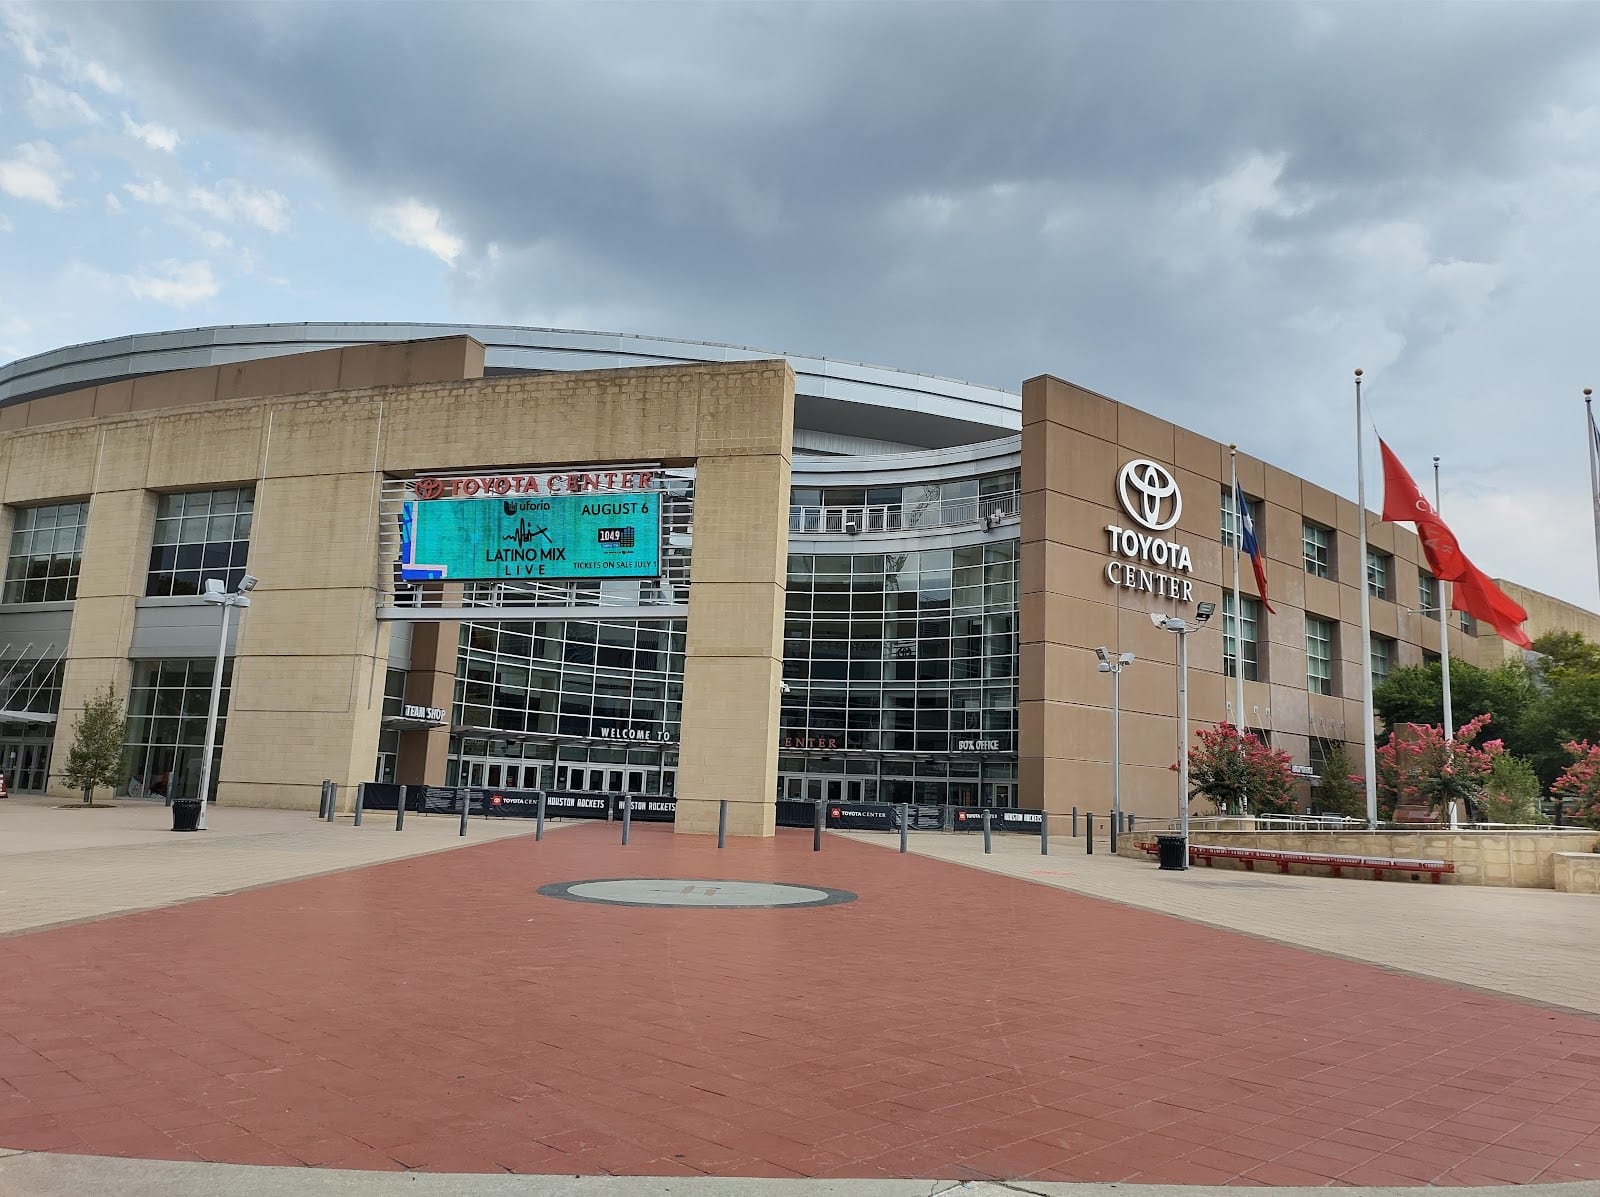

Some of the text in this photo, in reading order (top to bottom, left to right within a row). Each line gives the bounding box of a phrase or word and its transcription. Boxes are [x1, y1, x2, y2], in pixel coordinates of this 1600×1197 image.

[451, 472, 653, 496] TOYOTA CENTER
[520, 500, 550, 511] uforia
[582, 502, 649, 515] AUGUST 6
[486, 547, 566, 562] LATINO MIX
[1106, 525, 1193, 572] TOYOTA
[505, 564, 545, 576] LIVE
[602, 561, 615, 569] ON
[616, 561, 633, 569] SALE
[1105, 561, 1193, 602] CENTER
[404, 704, 446, 721] TEAM SHOP
[601, 727, 670, 741] WELCOME TO
[958, 740, 1000, 751] BOX OFFICE
[547, 796, 605, 809] HOUSTON ROCKETS
[618, 800, 676, 812] HSTON ROCKETS
